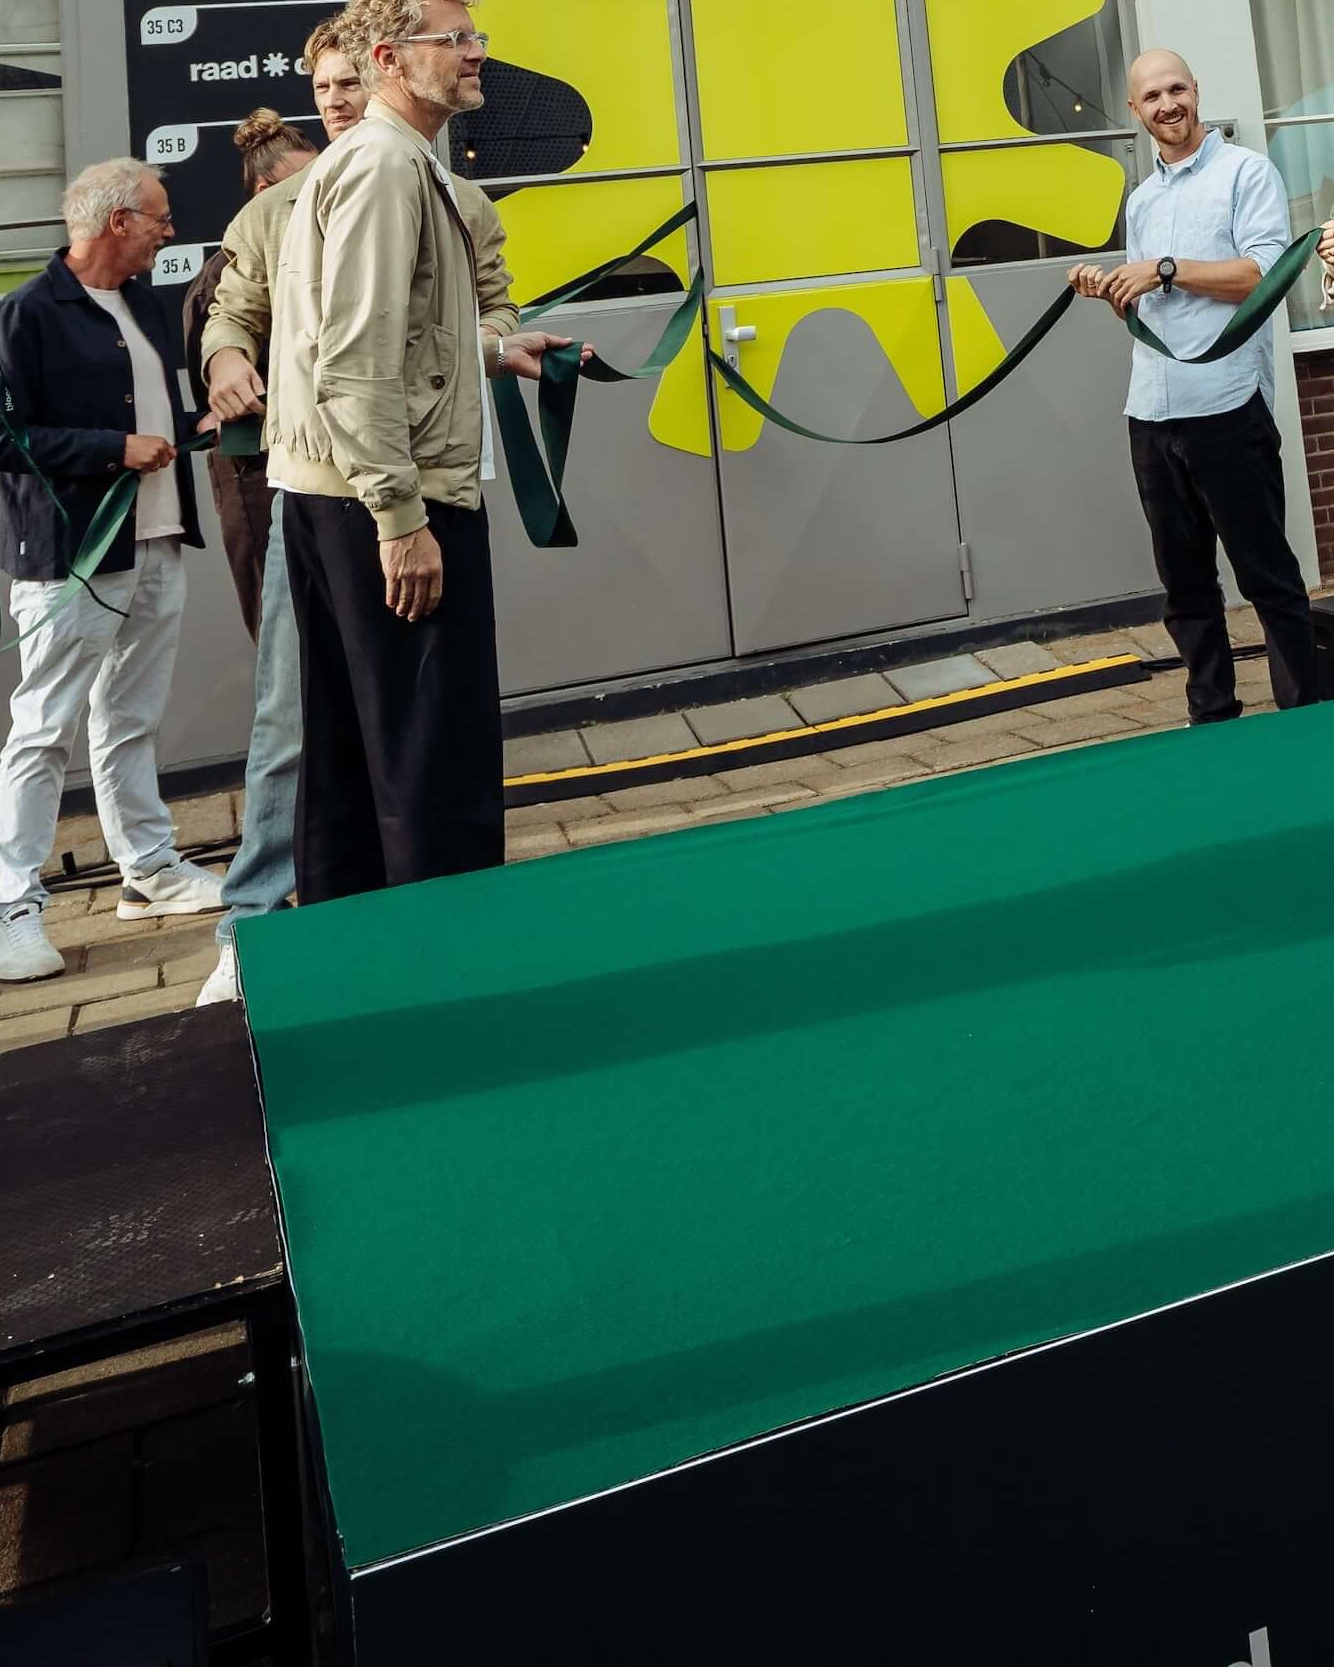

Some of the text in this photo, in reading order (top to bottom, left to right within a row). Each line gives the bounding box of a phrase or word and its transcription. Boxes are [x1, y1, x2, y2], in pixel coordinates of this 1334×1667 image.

[147, 18, 183, 35] 35 C3
[189, 54, 259, 82] raad
[157, 137, 186, 154] 35 B
[162, 257, 192, 274] 35 A
